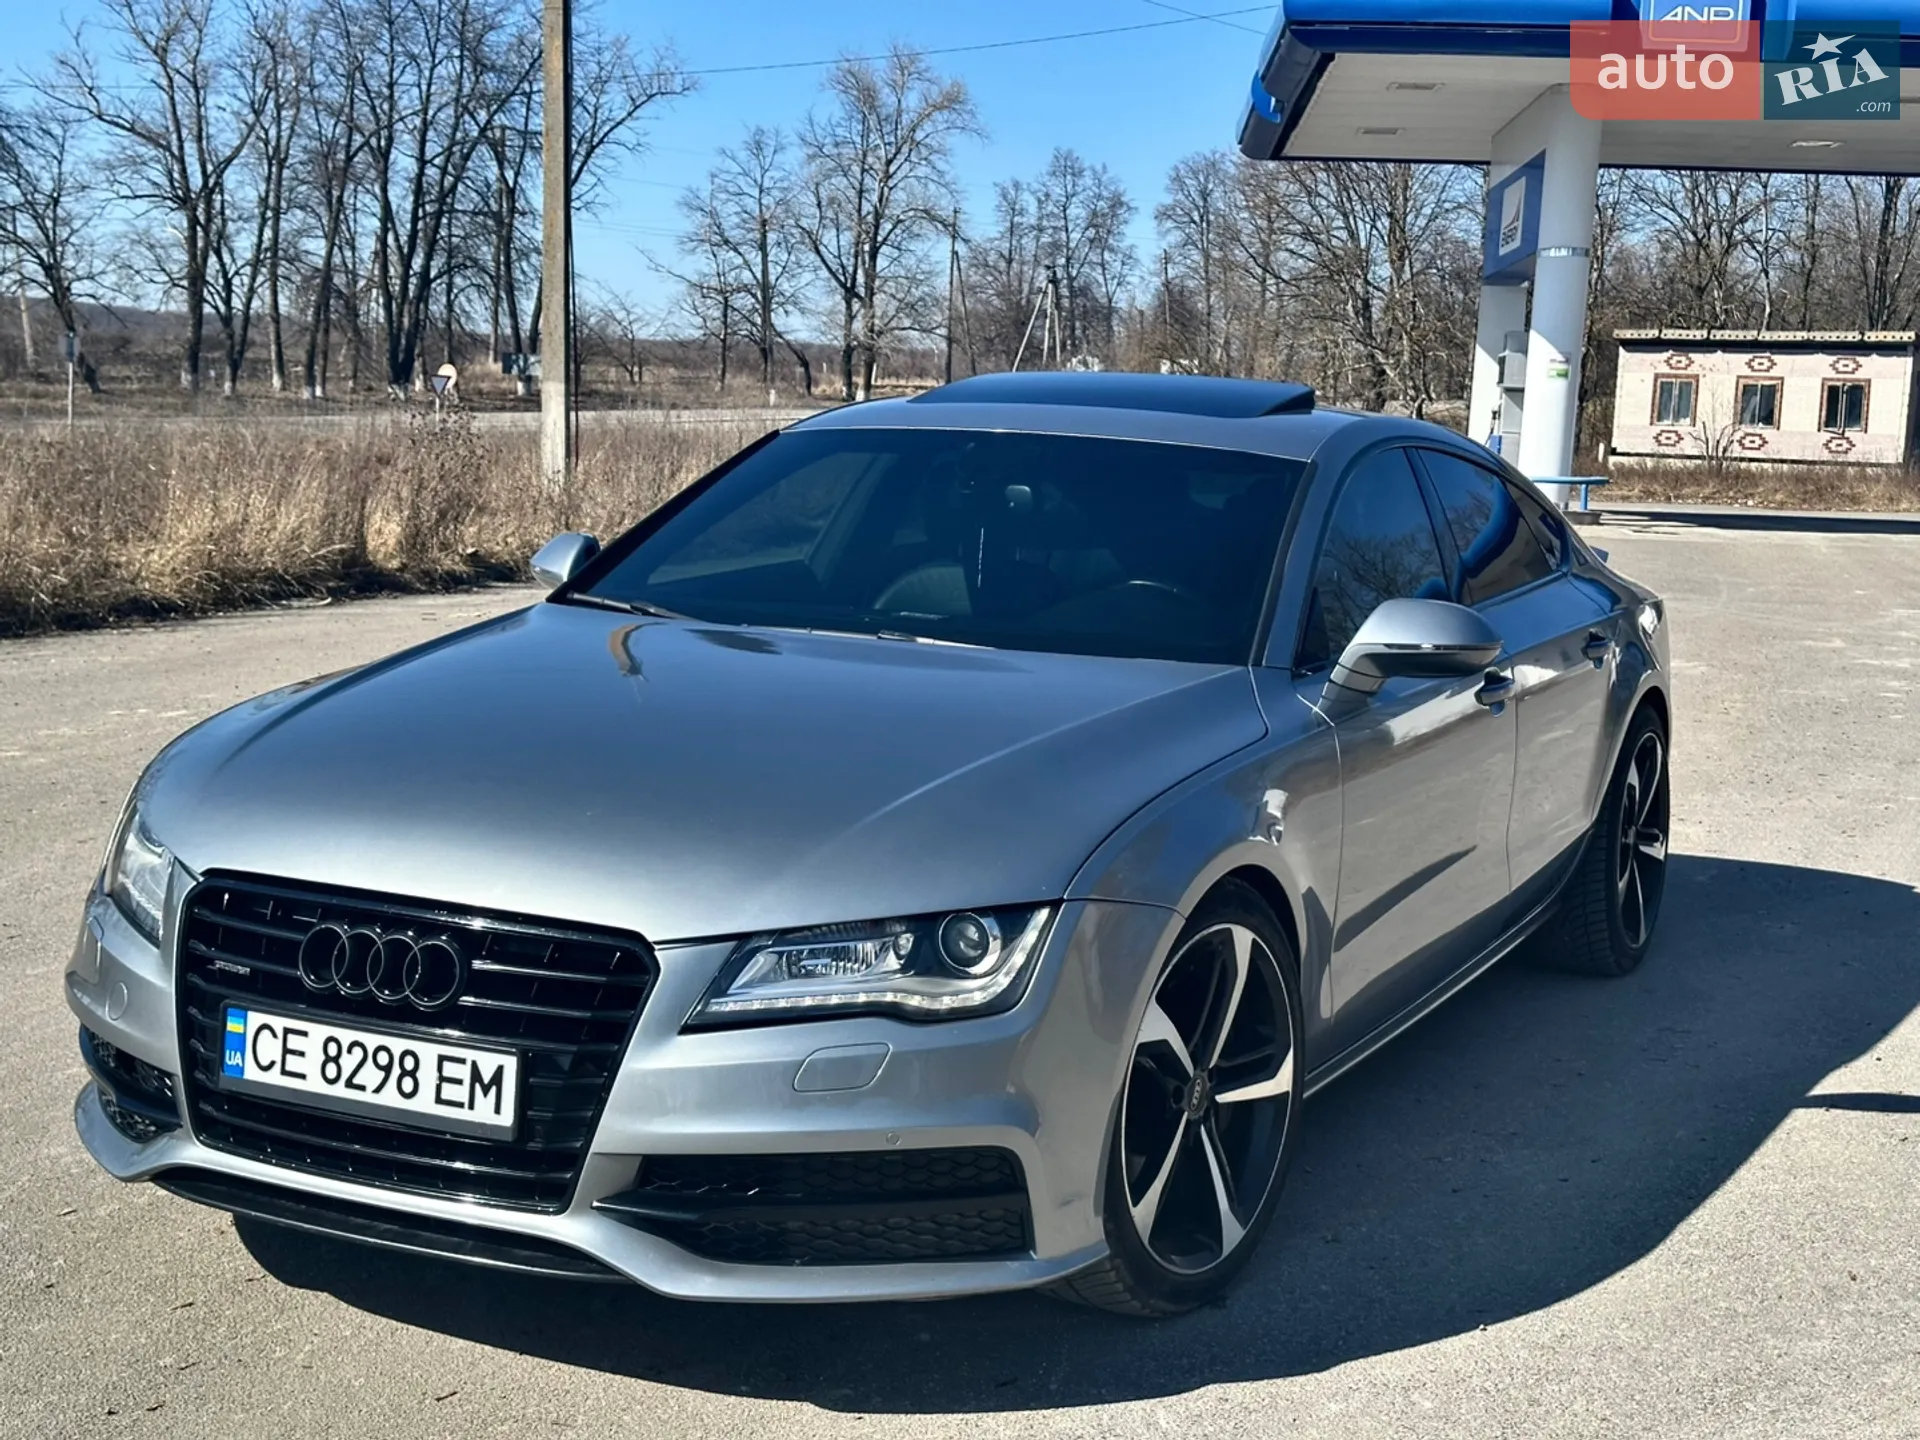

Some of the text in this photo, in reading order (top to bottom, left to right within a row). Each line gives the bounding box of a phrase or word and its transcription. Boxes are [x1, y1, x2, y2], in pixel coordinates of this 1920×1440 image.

[225, 1050, 243, 1067] UA
[252, 1022, 505, 1116] CE 8298 EM
